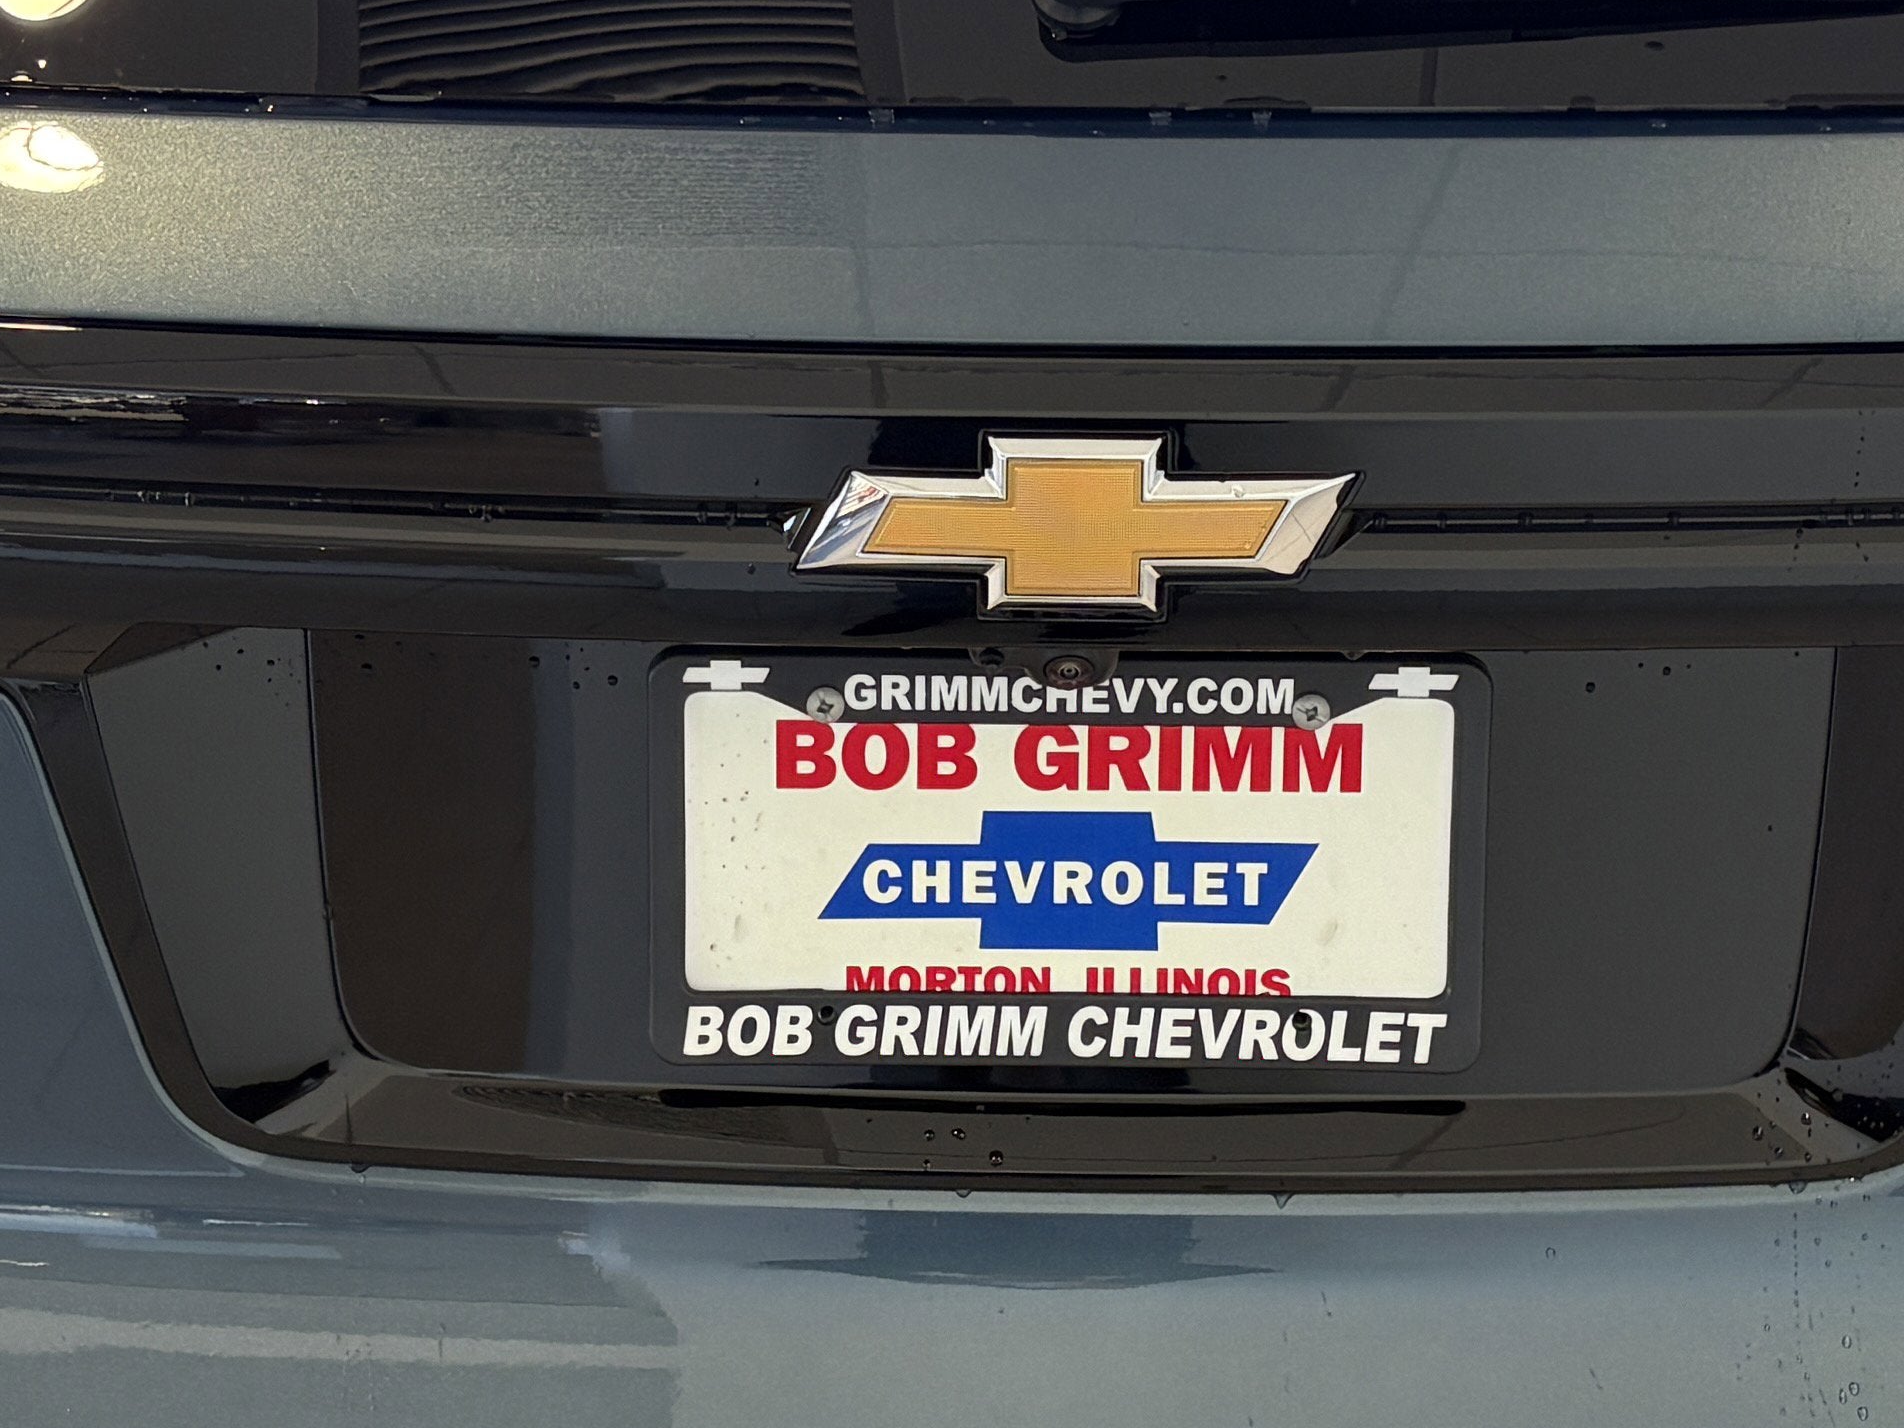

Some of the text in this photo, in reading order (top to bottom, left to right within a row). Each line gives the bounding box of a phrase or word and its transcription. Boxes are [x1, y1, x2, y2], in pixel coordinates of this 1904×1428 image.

[843, 673, 1295, 716] GRIMMCHEVY.COM
[776, 719, 1364, 794] BOB GRIMM
[861, 859, 1269, 907] CHEVROLET
[682, 1003, 1449, 1065] BOB GRIMM CHEVROLET
